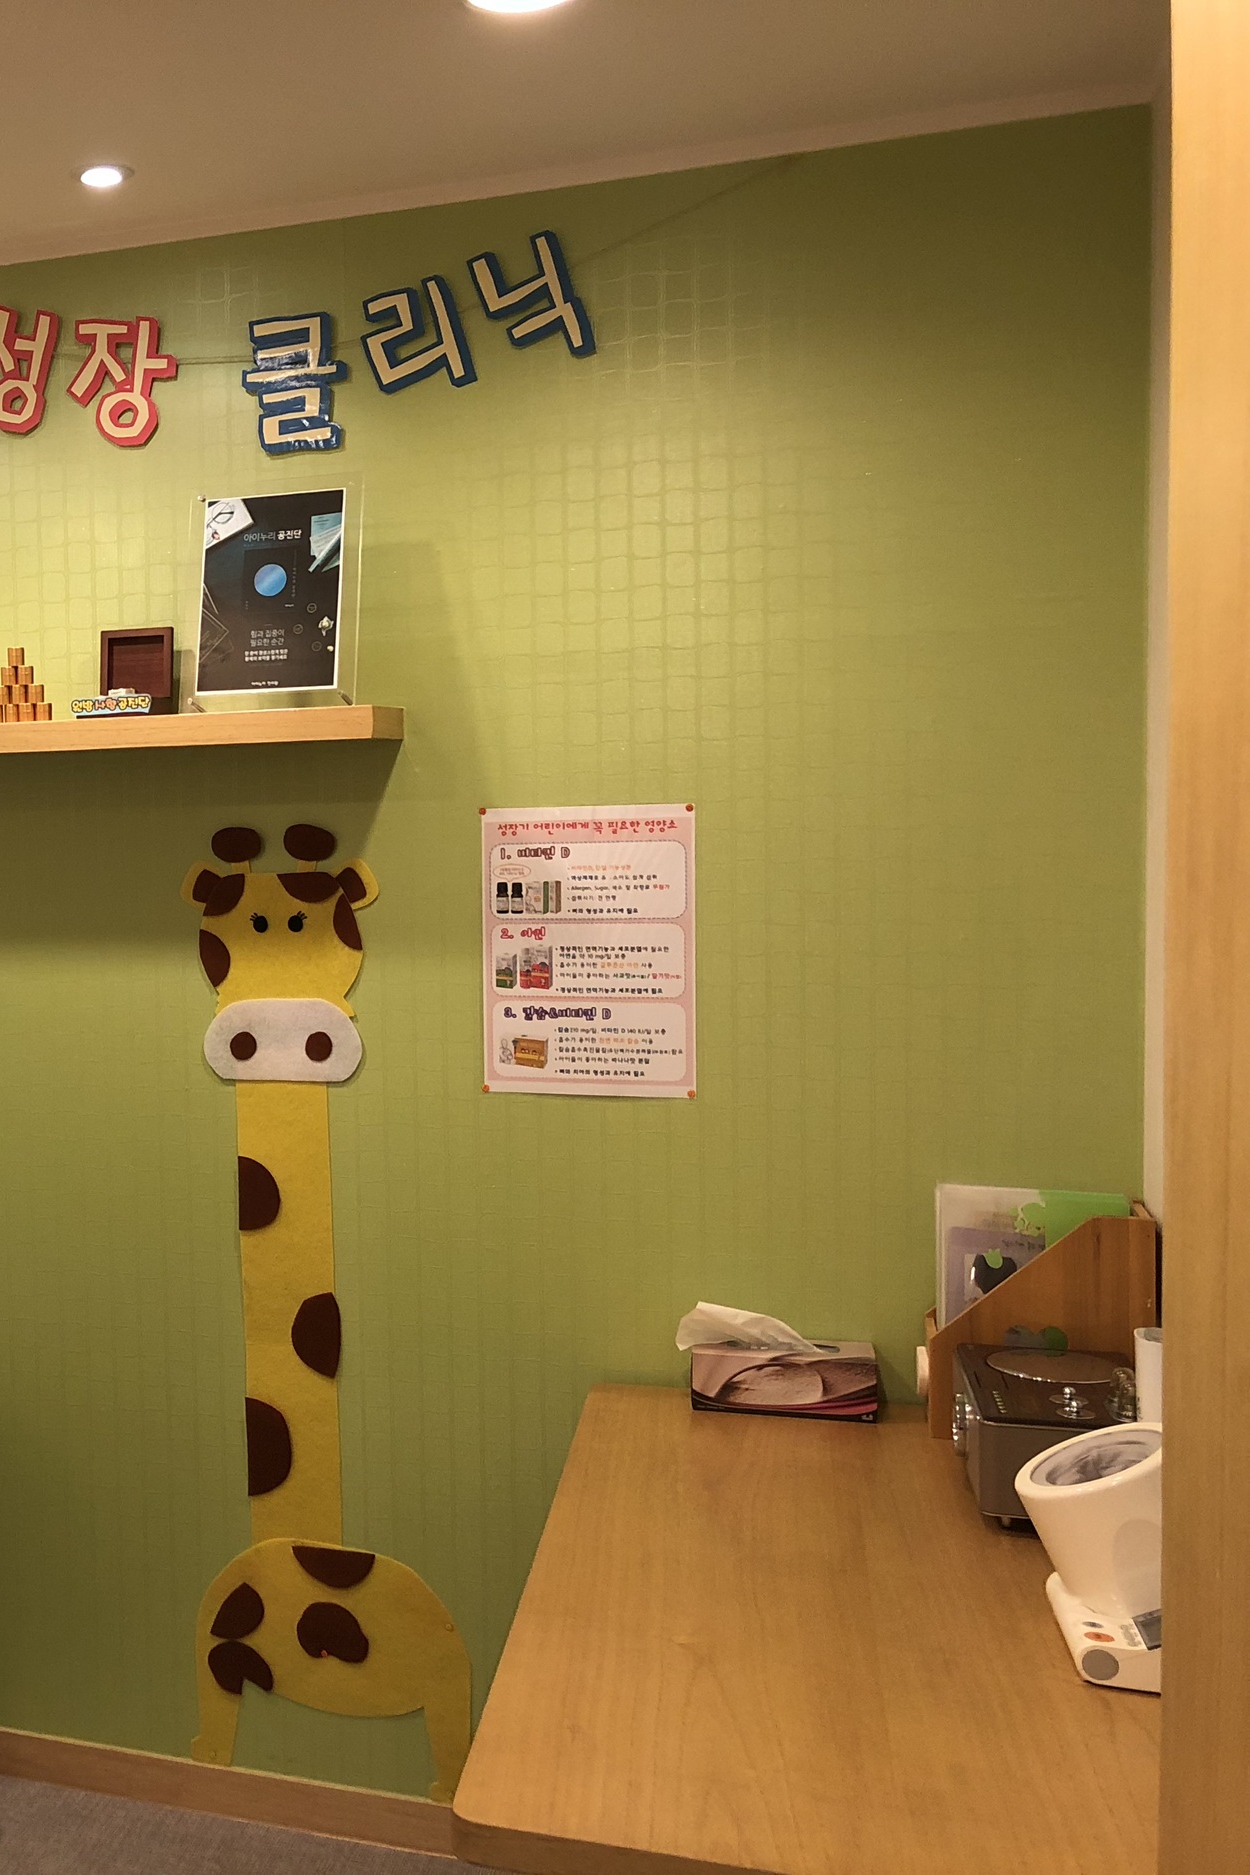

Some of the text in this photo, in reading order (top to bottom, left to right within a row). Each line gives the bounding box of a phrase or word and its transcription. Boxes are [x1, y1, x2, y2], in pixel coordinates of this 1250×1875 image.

[242, 230, 597, 456] 클리닉
[243, 529, 302, 542] 아이누리 공진단
[497, 819, 678, 836] 성장기 어린이에게 꼭 필요한 영양소
[560, 846, 571, 859] D
[602, 1007, 612, 1020] D
